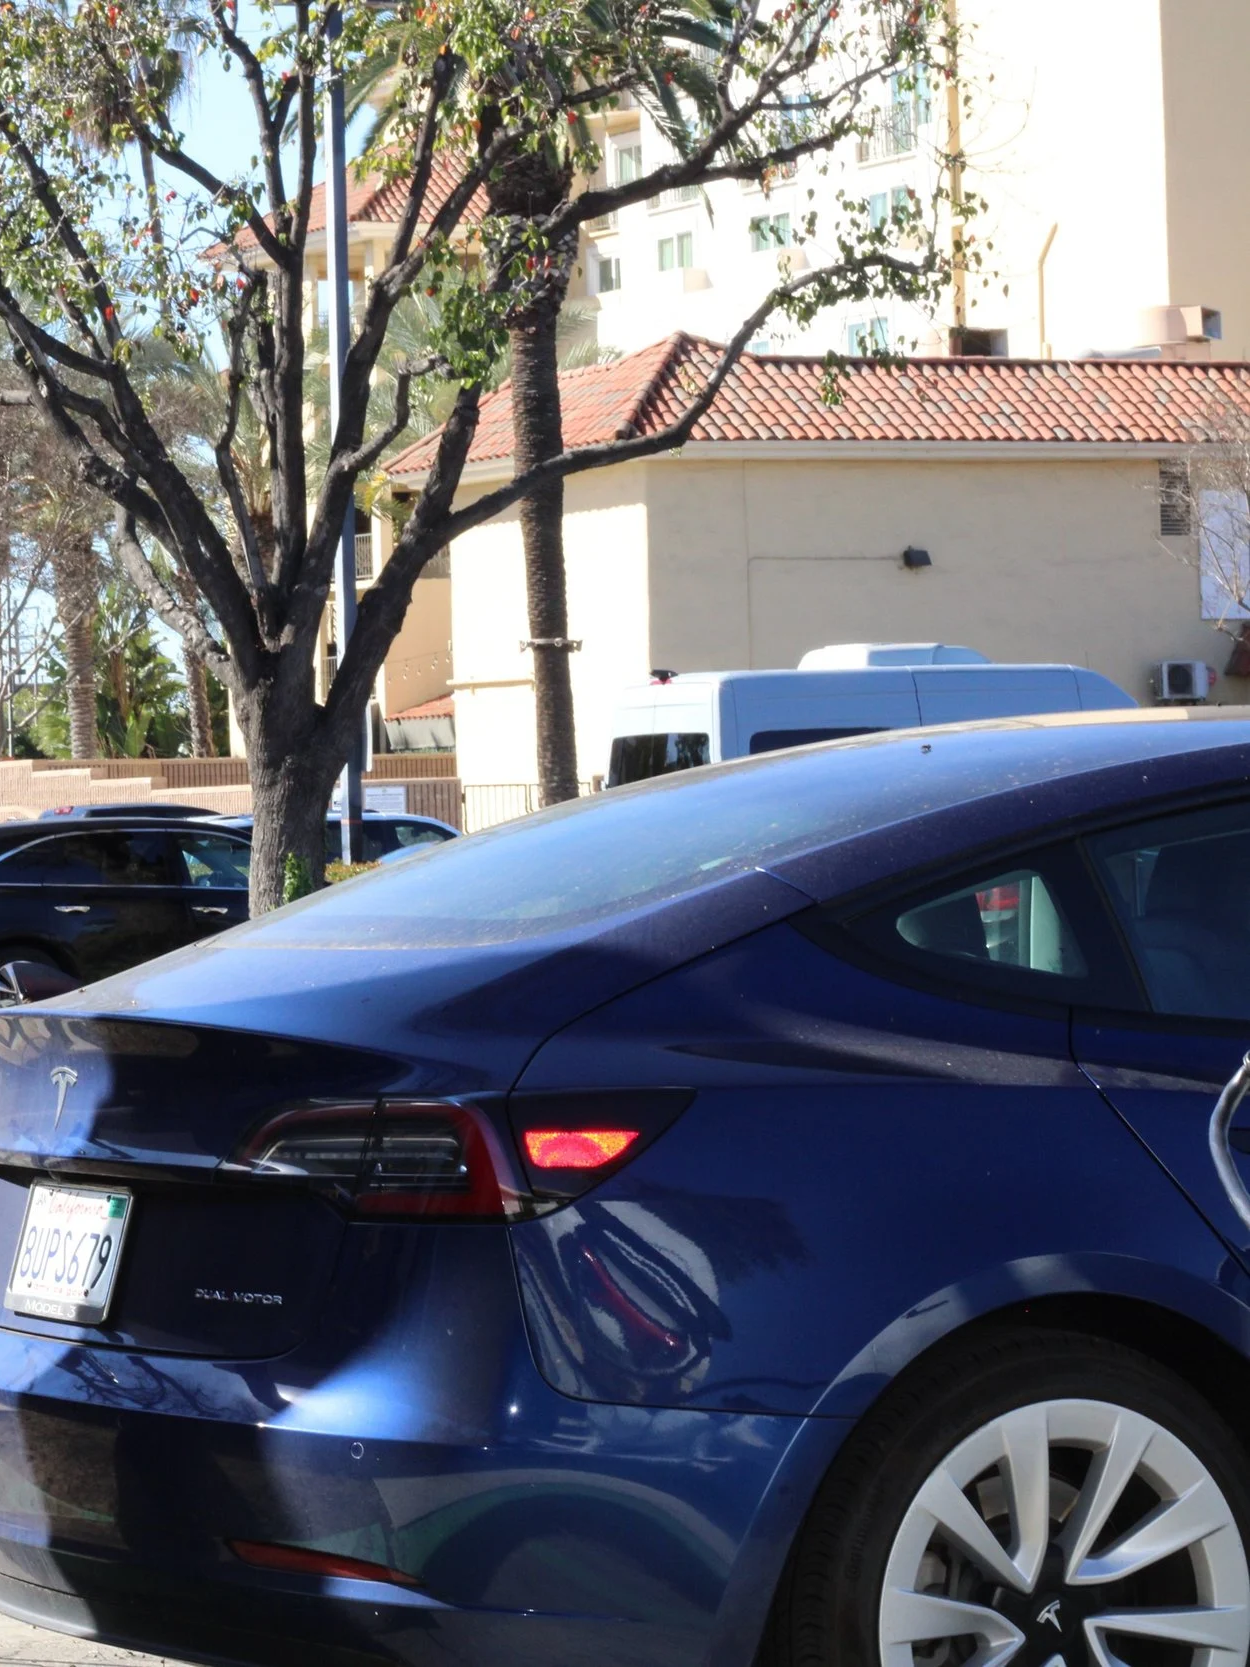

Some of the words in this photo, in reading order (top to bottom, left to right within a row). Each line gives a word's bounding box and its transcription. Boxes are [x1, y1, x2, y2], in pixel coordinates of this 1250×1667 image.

[20, 1226, 113, 1290] 8UPS679
[194, 1288, 229, 1300] DUAL
[233, 1291, 283, 1304] MOTOR
[24, 1299, 64, 1316] MODEL
[66, 1305, 77, 1318] 3
